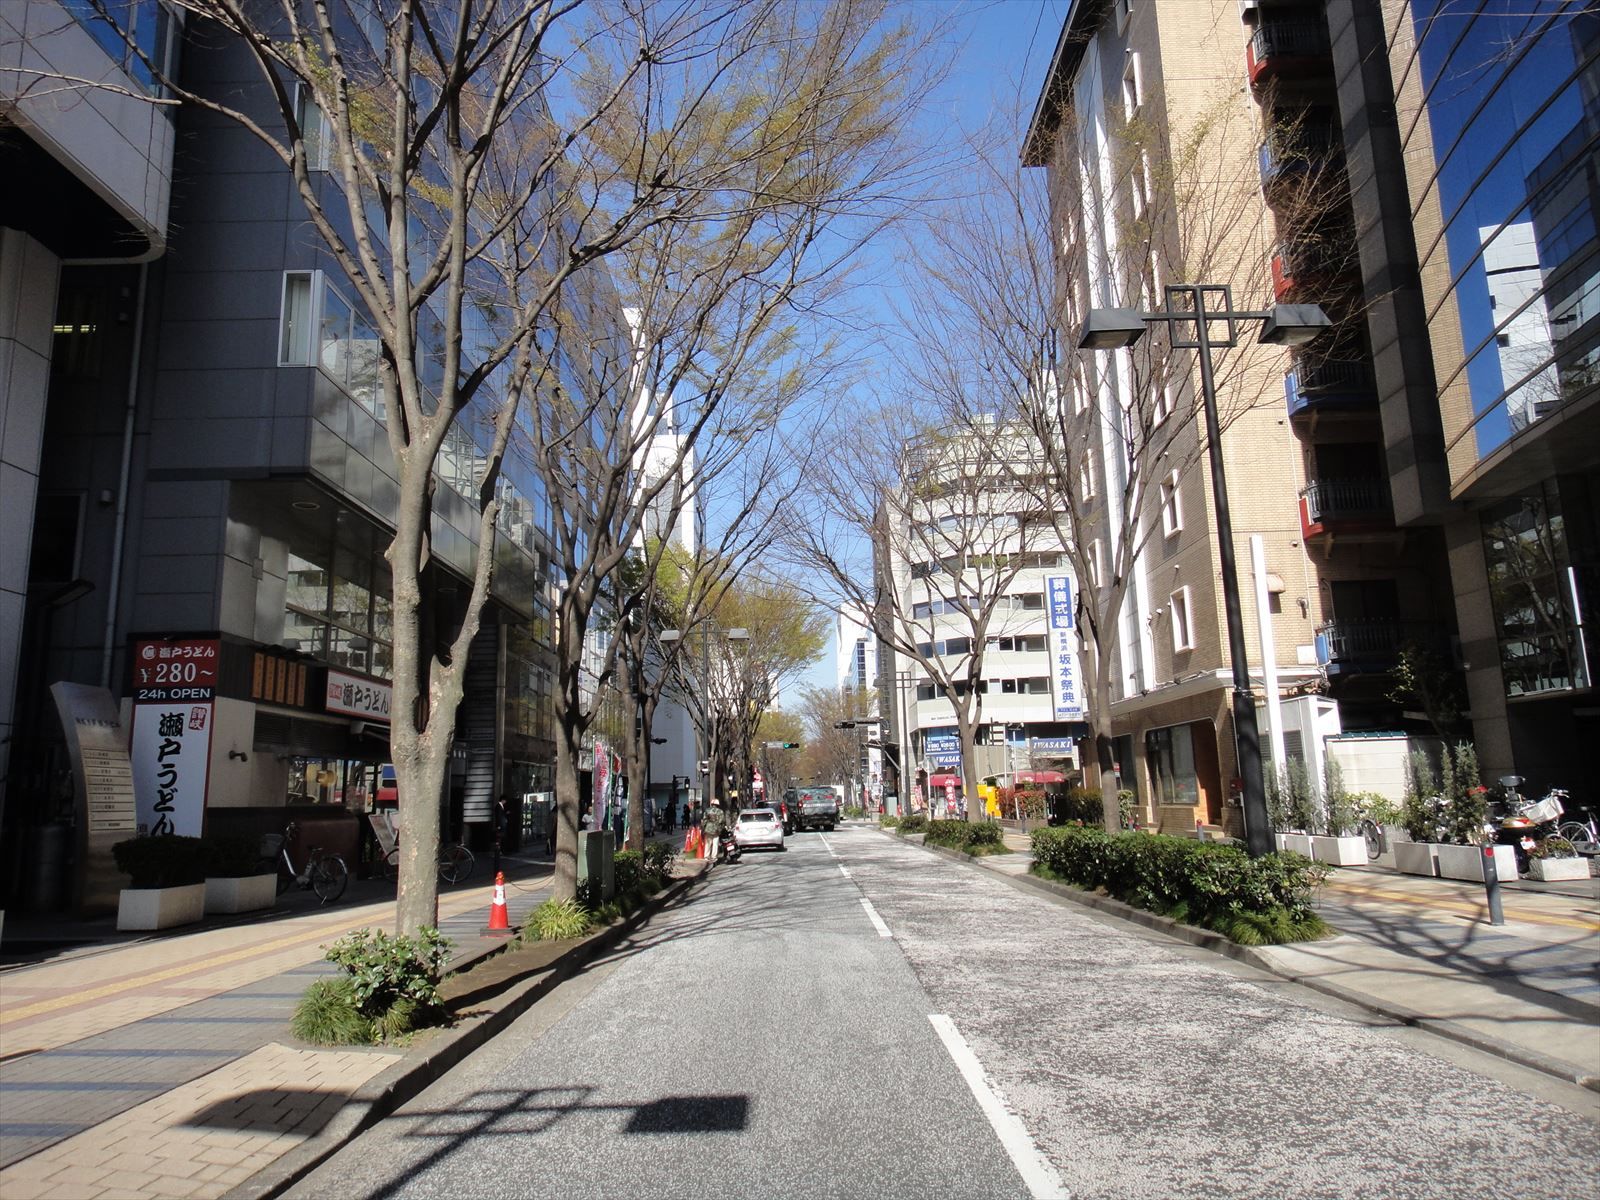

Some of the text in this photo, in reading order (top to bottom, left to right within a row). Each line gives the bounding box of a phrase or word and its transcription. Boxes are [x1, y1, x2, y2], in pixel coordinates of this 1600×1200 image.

[1052, 578, 1069, 628] 葬儀式場
[138, 688, 211, 700] 24h OPEN
[1058, 653, 1076, 704] 坂本祭典
[936, 755, 961, 763] IWASAK
[1033, 741, 1071, 749] IWASAKI
[151, 712, 185, 836] 瀬戸うどん
